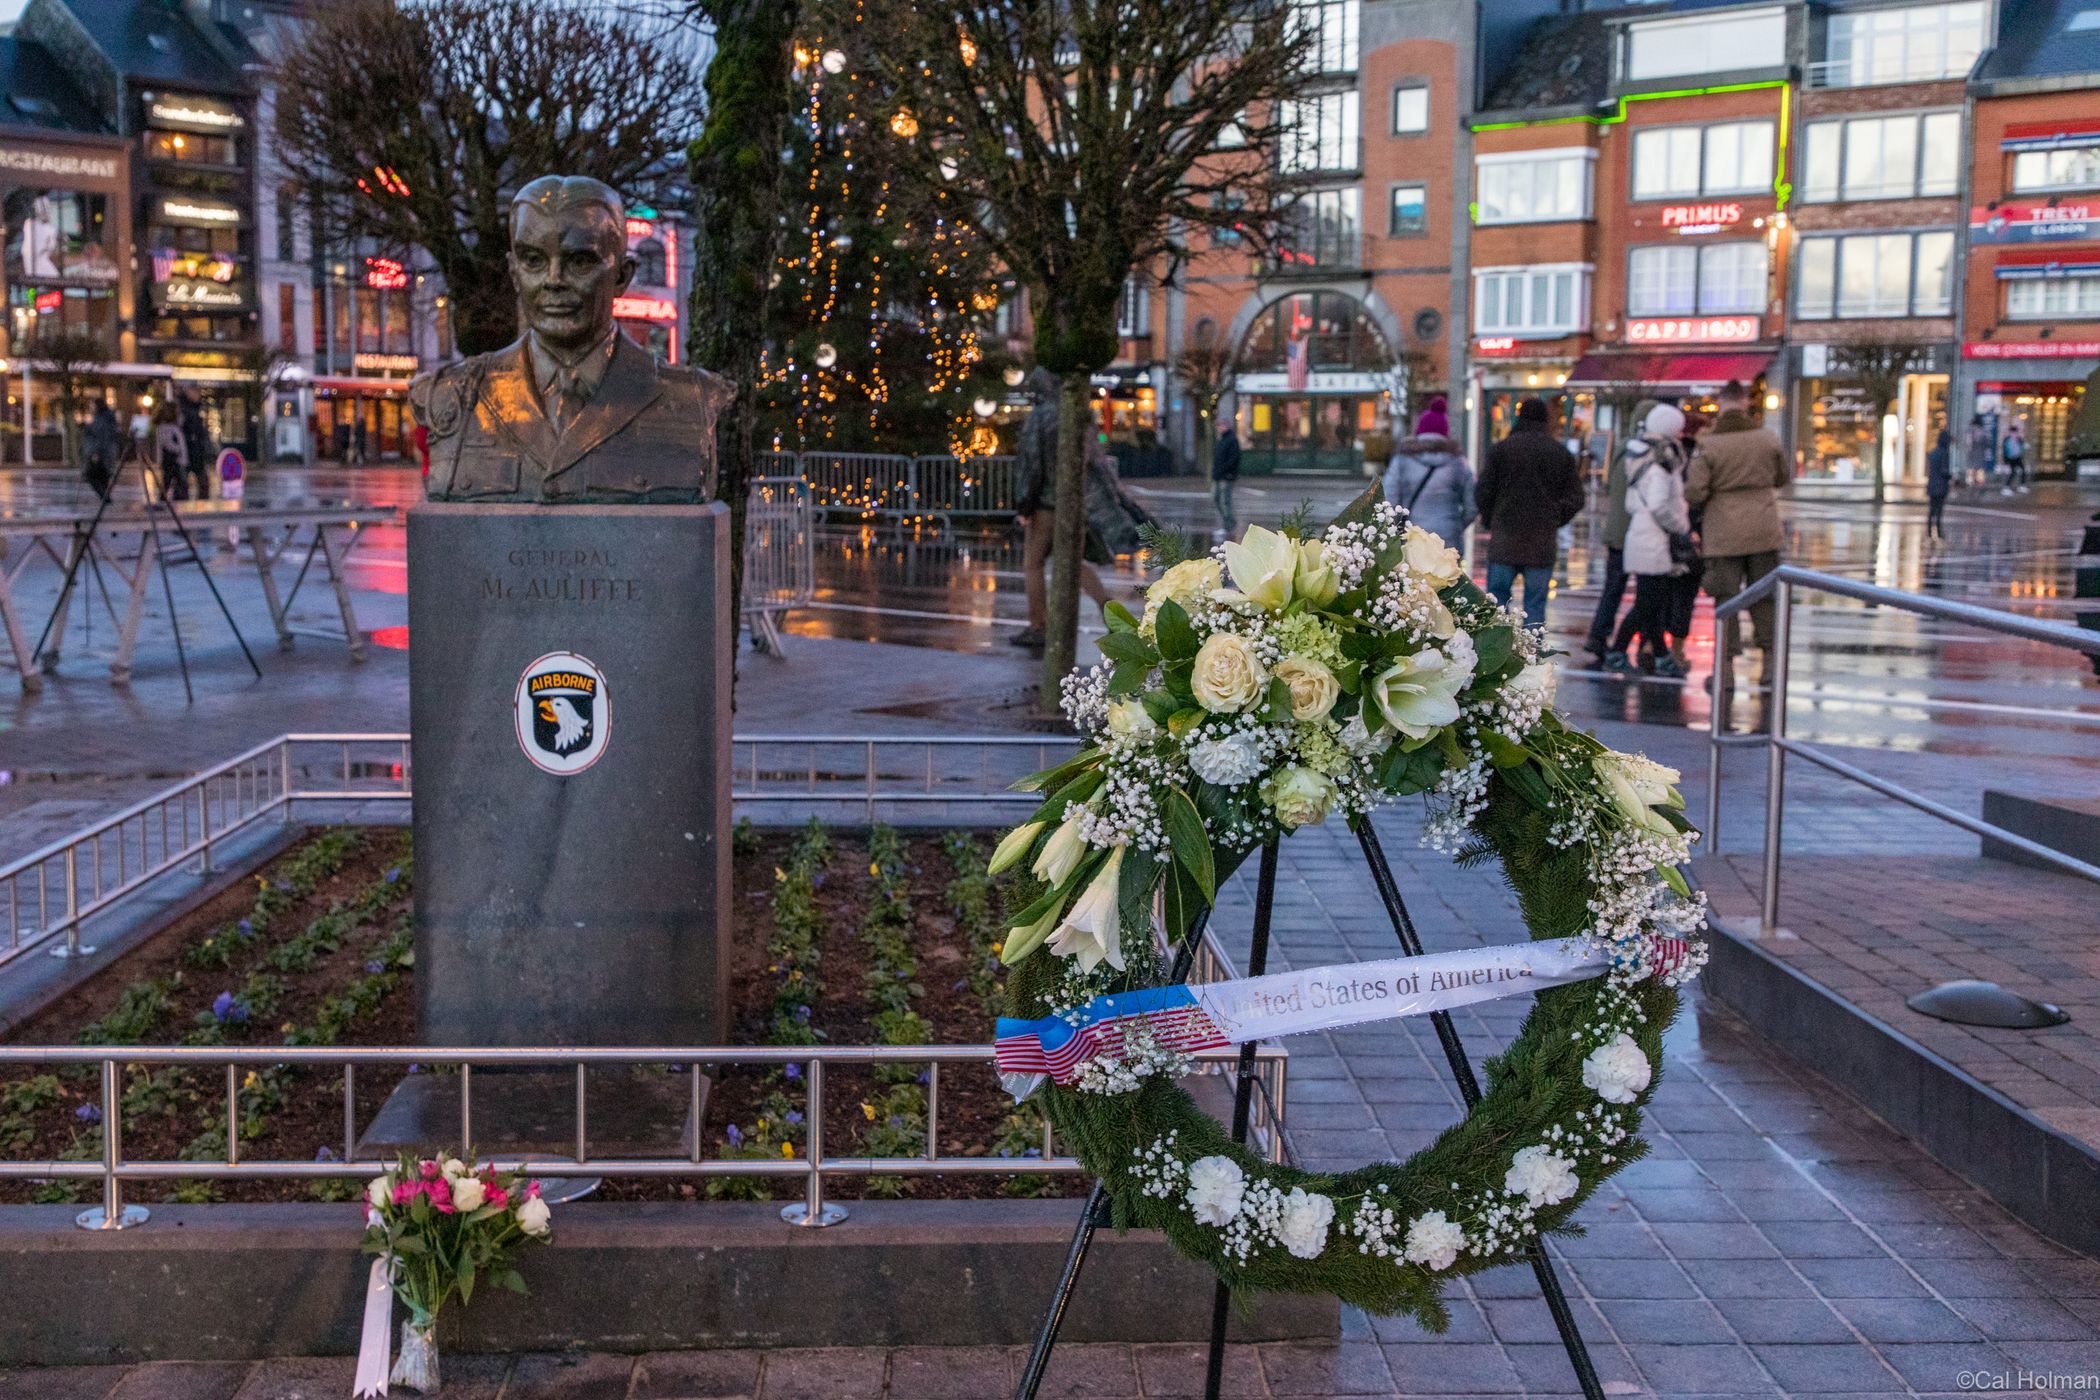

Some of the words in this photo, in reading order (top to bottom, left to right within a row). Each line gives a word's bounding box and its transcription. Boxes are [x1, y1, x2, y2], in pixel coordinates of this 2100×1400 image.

[1662, 204, 1742, 226] PRIMUS
[2031, 206, 2089, 220] TREVI
[2031, 223, 2087, 235] CLOSON
[508, 550, 617, 567] GENERAL
[530, 673, 595, 692] AIRBORNE
[1309, 976, 1388, 1009] States
[1430, 966, 1533, 992] America
